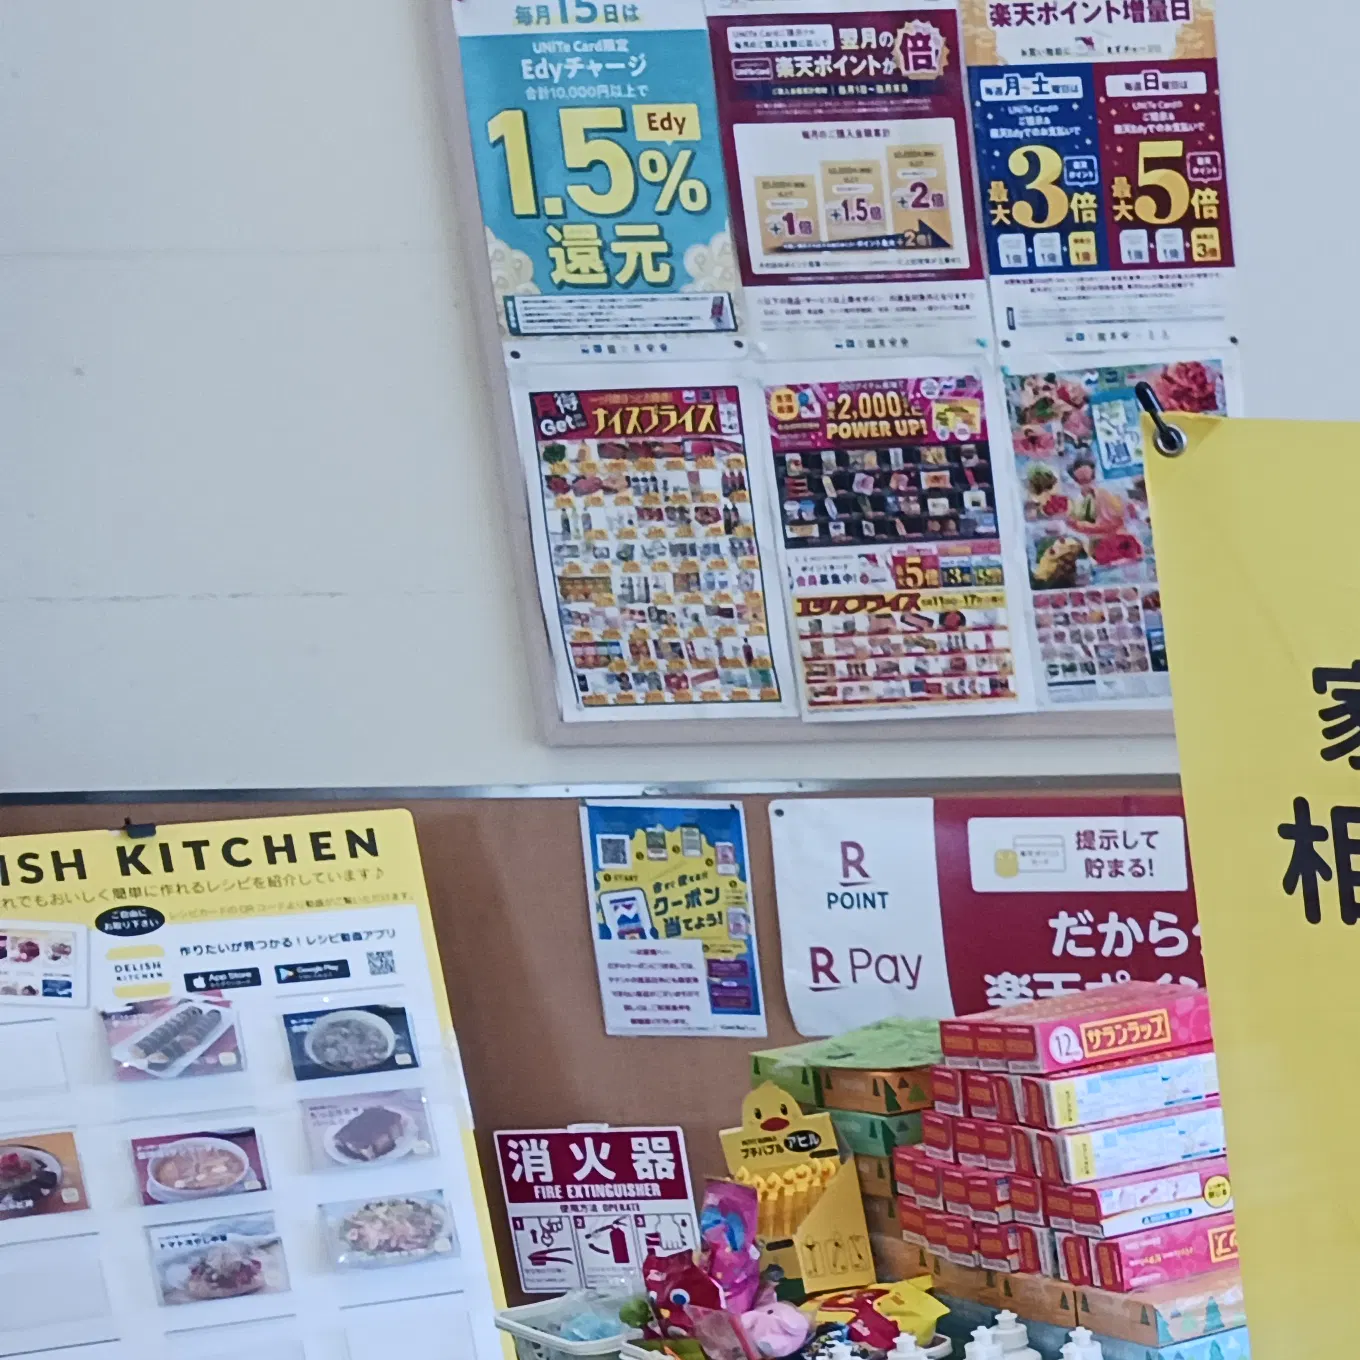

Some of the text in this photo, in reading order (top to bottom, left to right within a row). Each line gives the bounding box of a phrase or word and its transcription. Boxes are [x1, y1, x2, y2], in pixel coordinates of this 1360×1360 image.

[989, 0, 1191, 28] 楽天ポイント増量日
[521, 55, 647, 83] Edyチャージ
[647, 112, 686, 135] Edy
[486, 106, 709, 218] 1.5%
[548, 223, 672, 288] 還元
[592, 404, 717, 436] ナイスプライス
[826, 417, 928, 440] POWER UP!
[115, 826, 380, 878] KITCHEN
[1075, 829, 1160, 852] 提示して
[840, 841, 870, 879] R
[1084, 857, 1155, 880] 貯まる!
[653, 887, 721, 916] クーポン
[826, 891, 889, 910] POINT
[1048, 910, 1201, 958] だから
[114, 962, 163, 974] DELISH
[808, 947, 923, 990] R Pay
[1086, 1016, 1167, 1051] サランラップ
[507, 1136, 676, 1184] 消火器
[534, 1182, 662, 1200] FIRE EXTINGUISHER
